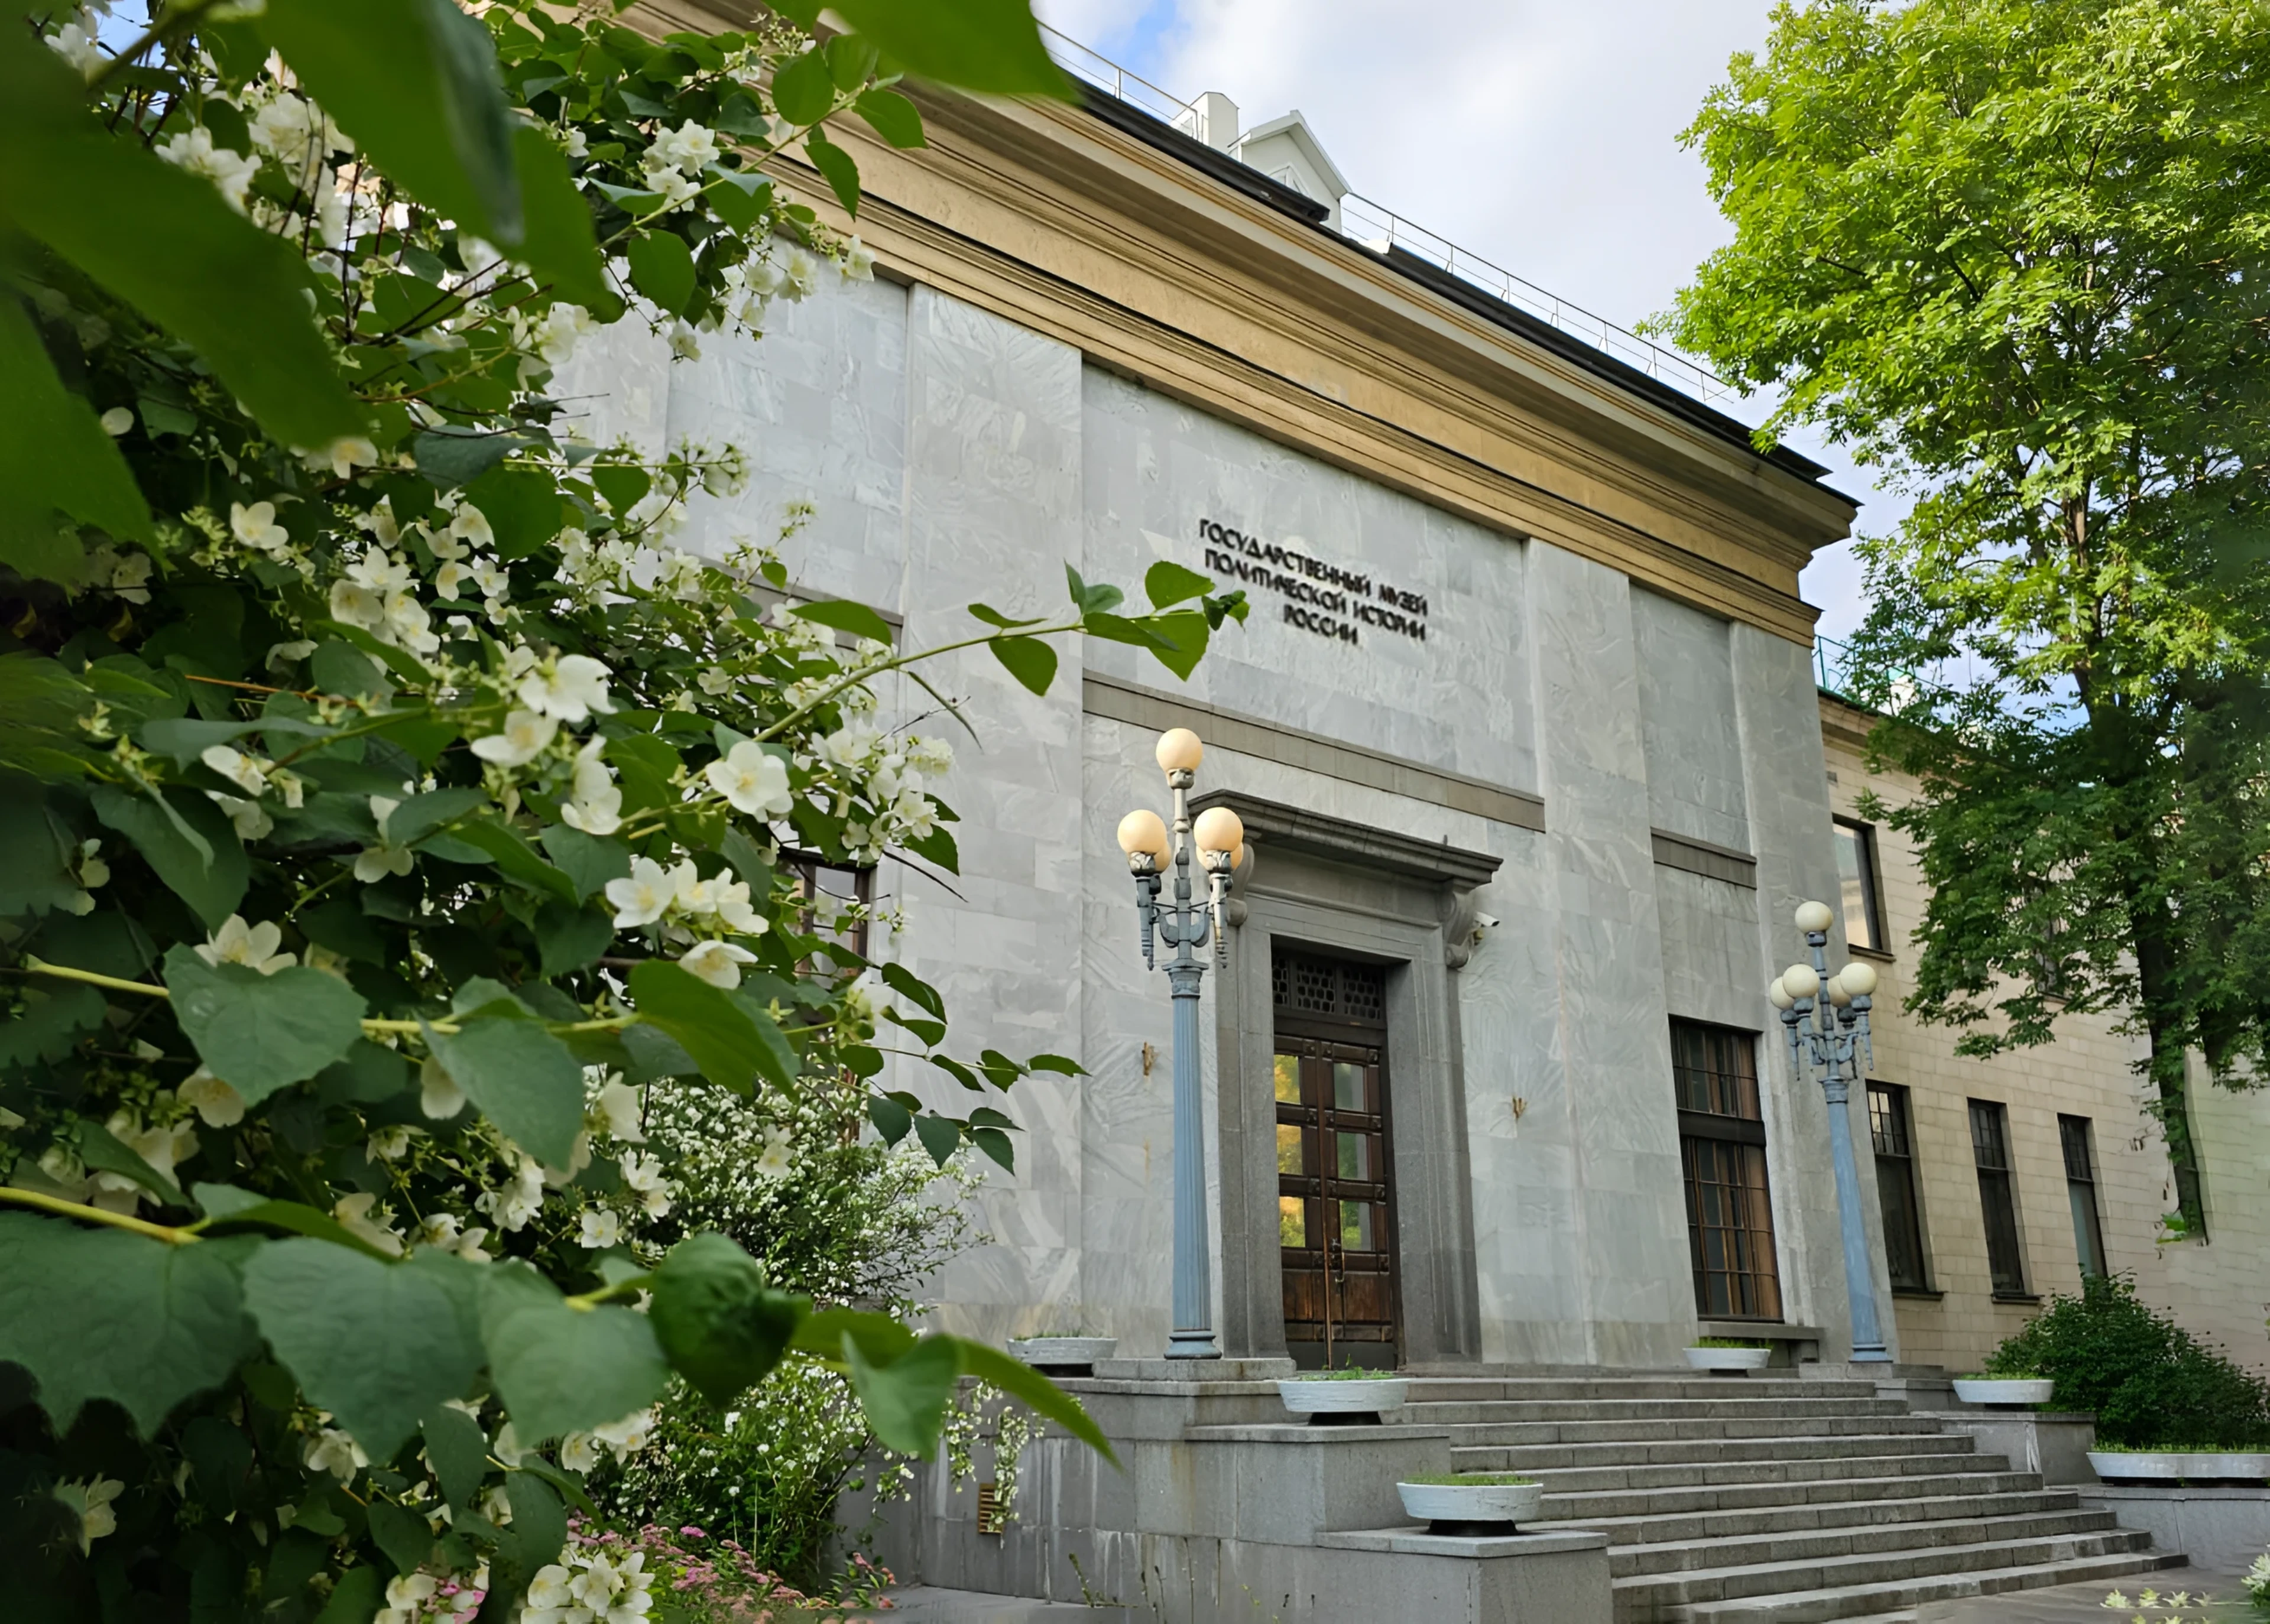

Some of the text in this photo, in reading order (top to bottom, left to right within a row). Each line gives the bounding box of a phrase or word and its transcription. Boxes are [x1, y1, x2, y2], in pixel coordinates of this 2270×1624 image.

[1199, 518, 1428, 616] ГОСУДАРСТВЕННЫЙ МУЗЕЙ
[1284, 603, 1358, 644] РОССИИ
[1353, 600, 1426, 641] ИСТОРИИ
